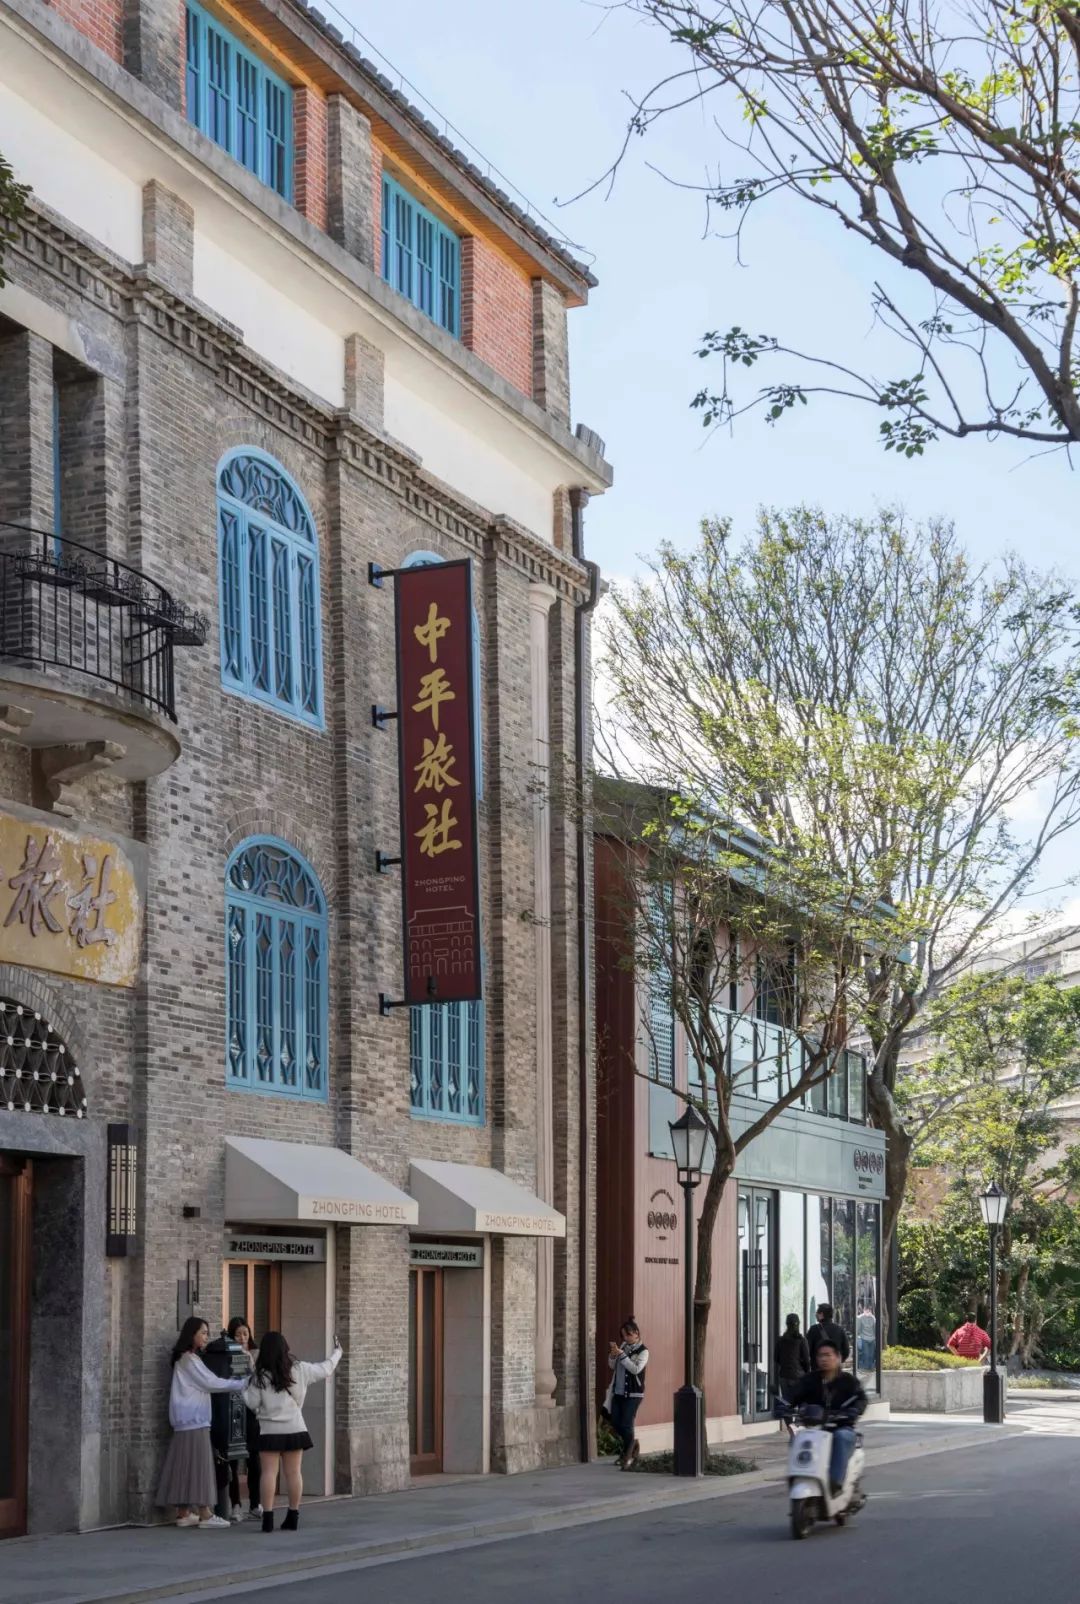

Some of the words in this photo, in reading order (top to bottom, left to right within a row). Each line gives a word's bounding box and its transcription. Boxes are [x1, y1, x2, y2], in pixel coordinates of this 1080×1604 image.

[412, 602, 462, 858] 中平旅社
[413, 875, 466, 887] ZHONGPING
[425, 884, 455, 893] HOTEL
[312, 1201, 373, 1217] ZHONGPING
[375, 1205, 407, 1220] HOTEL
[485, 1214, 531, 1229] ZHONGPING
[532, 1216, 557, 1232] HOTEL
